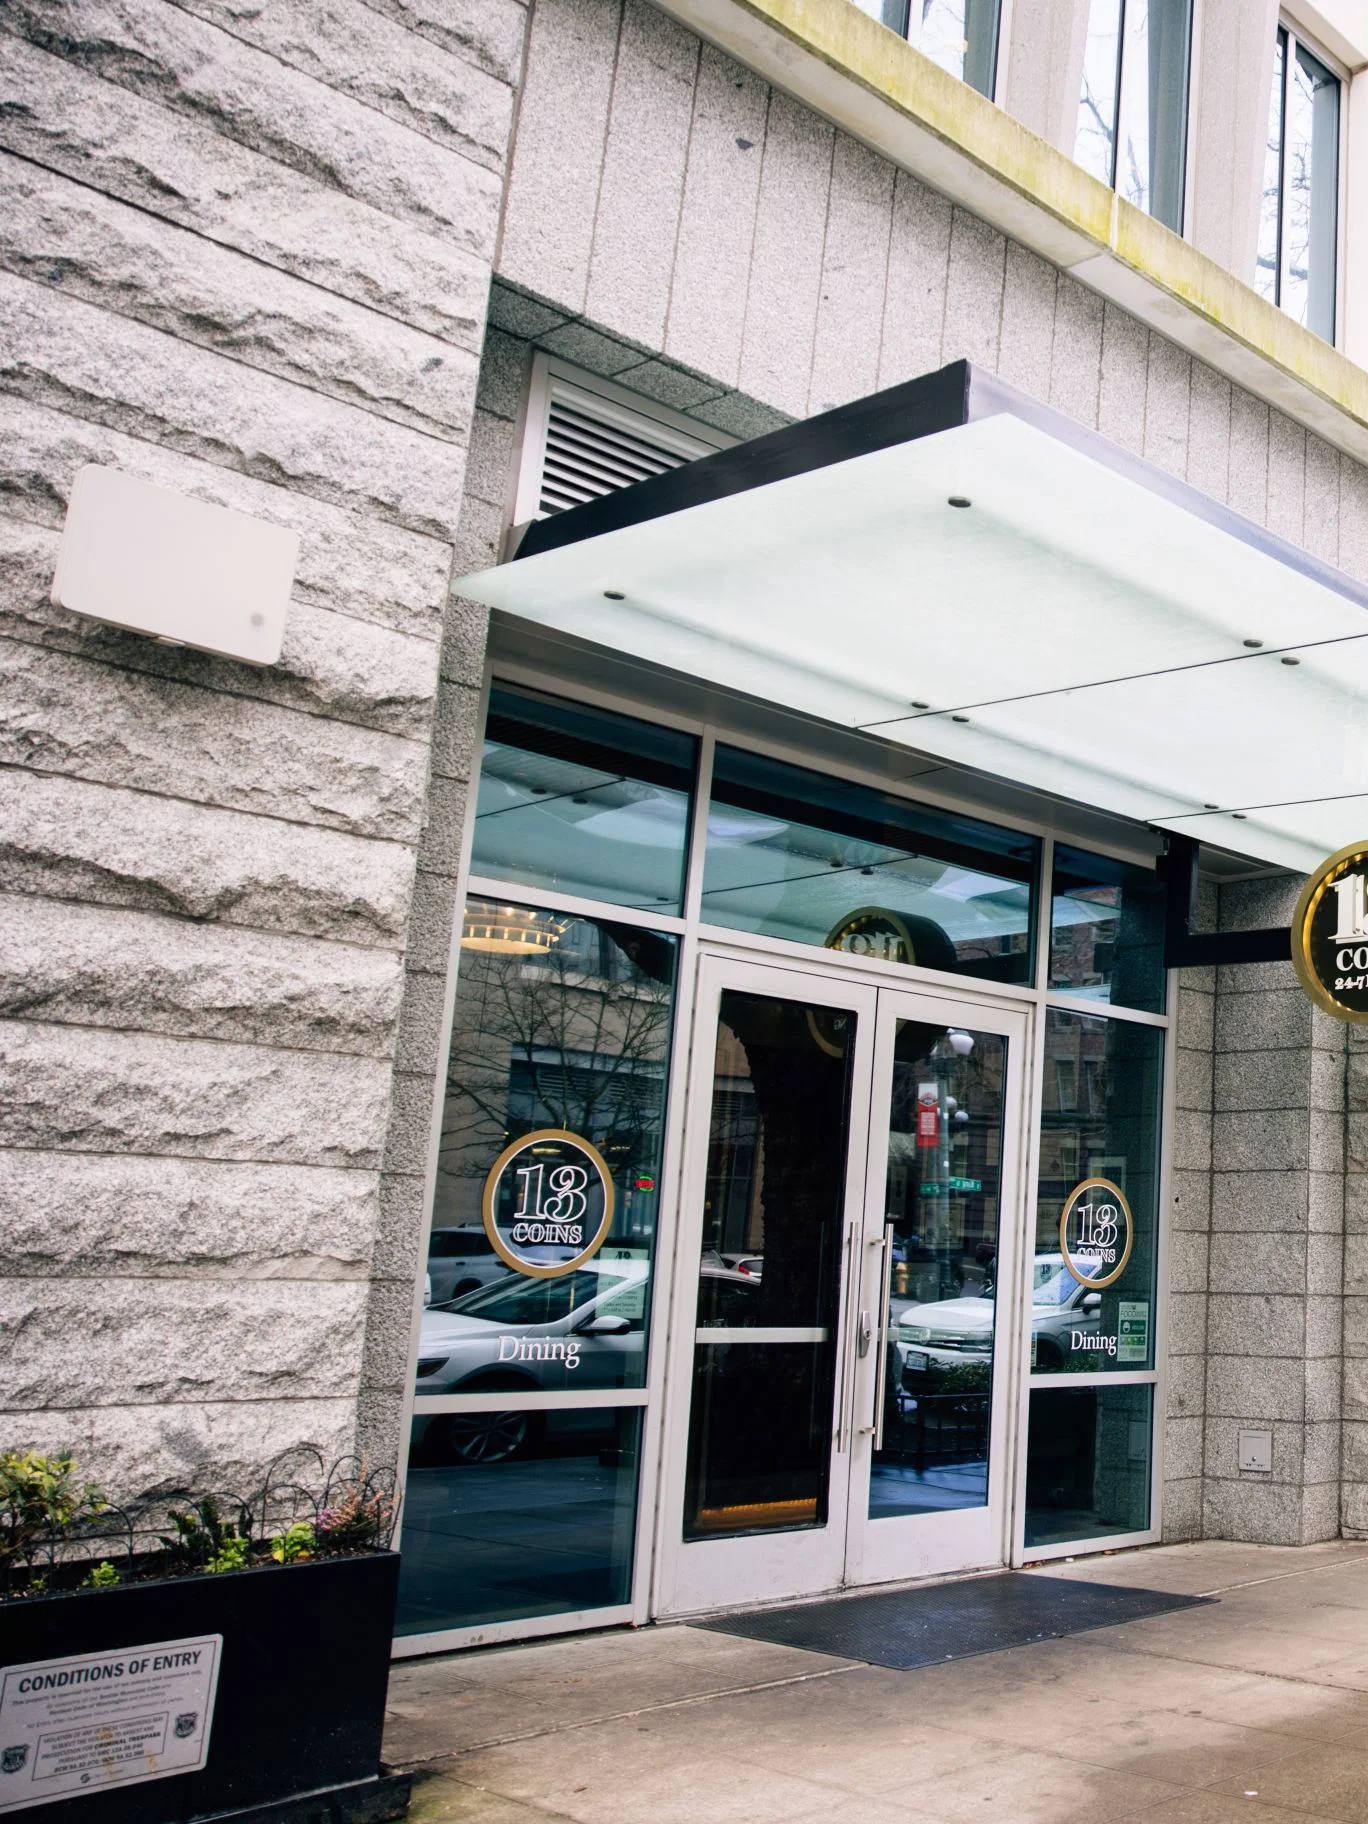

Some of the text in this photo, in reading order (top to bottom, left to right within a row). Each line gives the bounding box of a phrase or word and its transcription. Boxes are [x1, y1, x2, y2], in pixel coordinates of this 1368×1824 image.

[513, 1163, 588, 1223] 13
[512, 1222, 583, 1244] COINS
[1076, 1203, 1118, 1247] 13
[498, 1335, 581, 1369] Dining
[1071, 1331, 1117, 1356] Dining
[18, 1662, 124, 1694] CONDITIONS
[128, 1658, 150, 1675] OF
[153, 1649, 202, 1671] ENTRY
